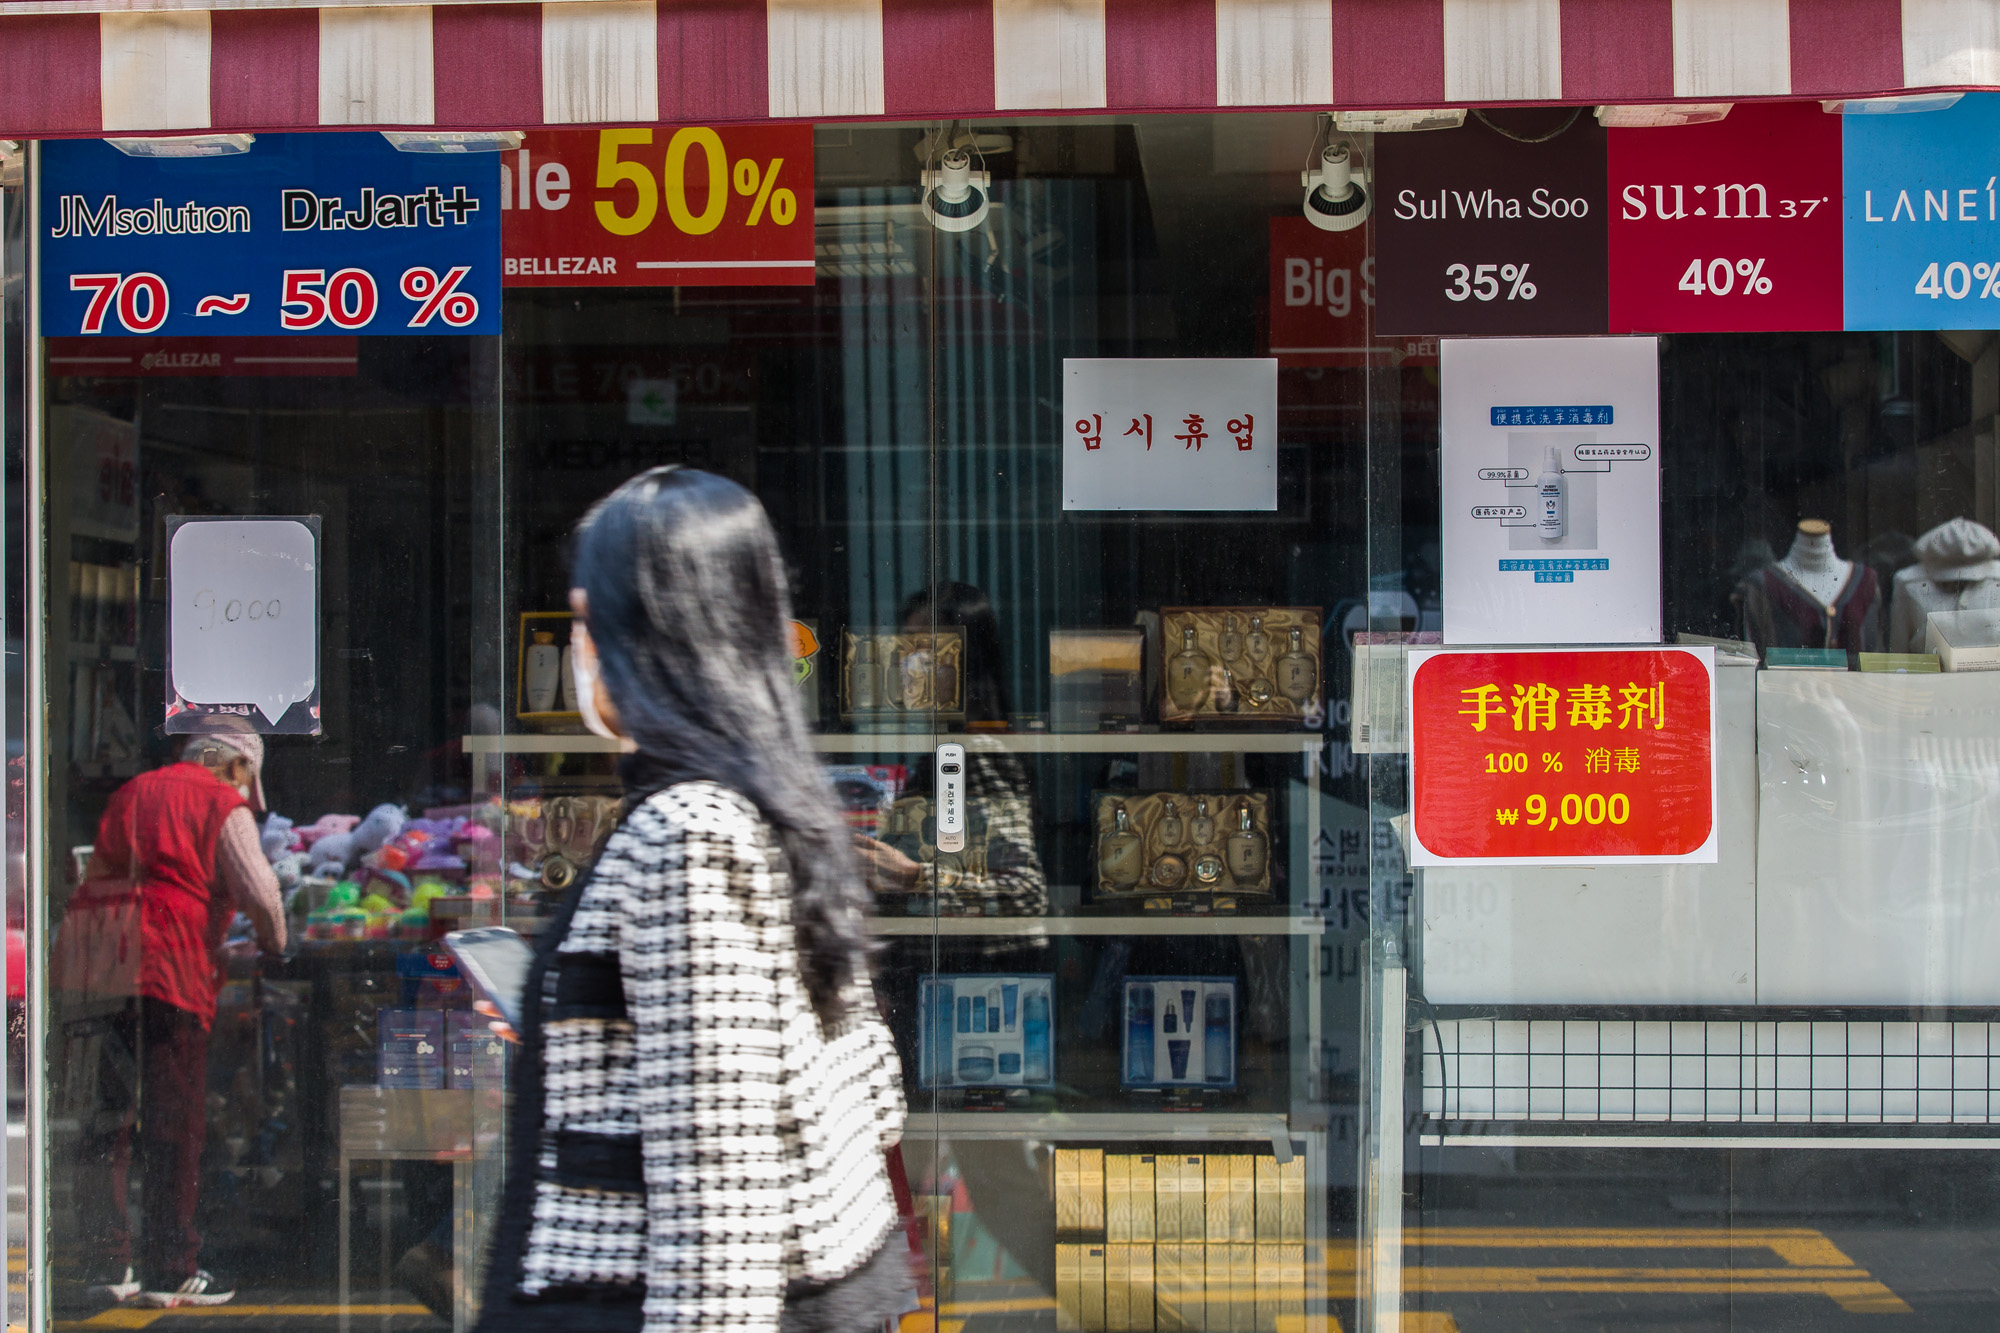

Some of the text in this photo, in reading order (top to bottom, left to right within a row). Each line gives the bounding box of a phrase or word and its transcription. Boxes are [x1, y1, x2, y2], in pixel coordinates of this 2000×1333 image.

[594, 127, 797, 236] 50%
[1622, 183, 1772, 221] su:m
[52, 186, 480, 238] JMsolution Dr.Jart+
[505, 257, 617, 275] BELLEZAR
[1285, 257, 1351, 317] Big
[1445, 263, 1537, 302] 35%
[1678, 257, 1773, 296] 40%
[70, 271, 170, 335] 70
[281, 267, 378, 331] 50
[400, 265, 479, 328] %
[1457, 681, 1666, 732] 手消毒剂
[1484, 746, 1641, 774] 100 % 消毒
